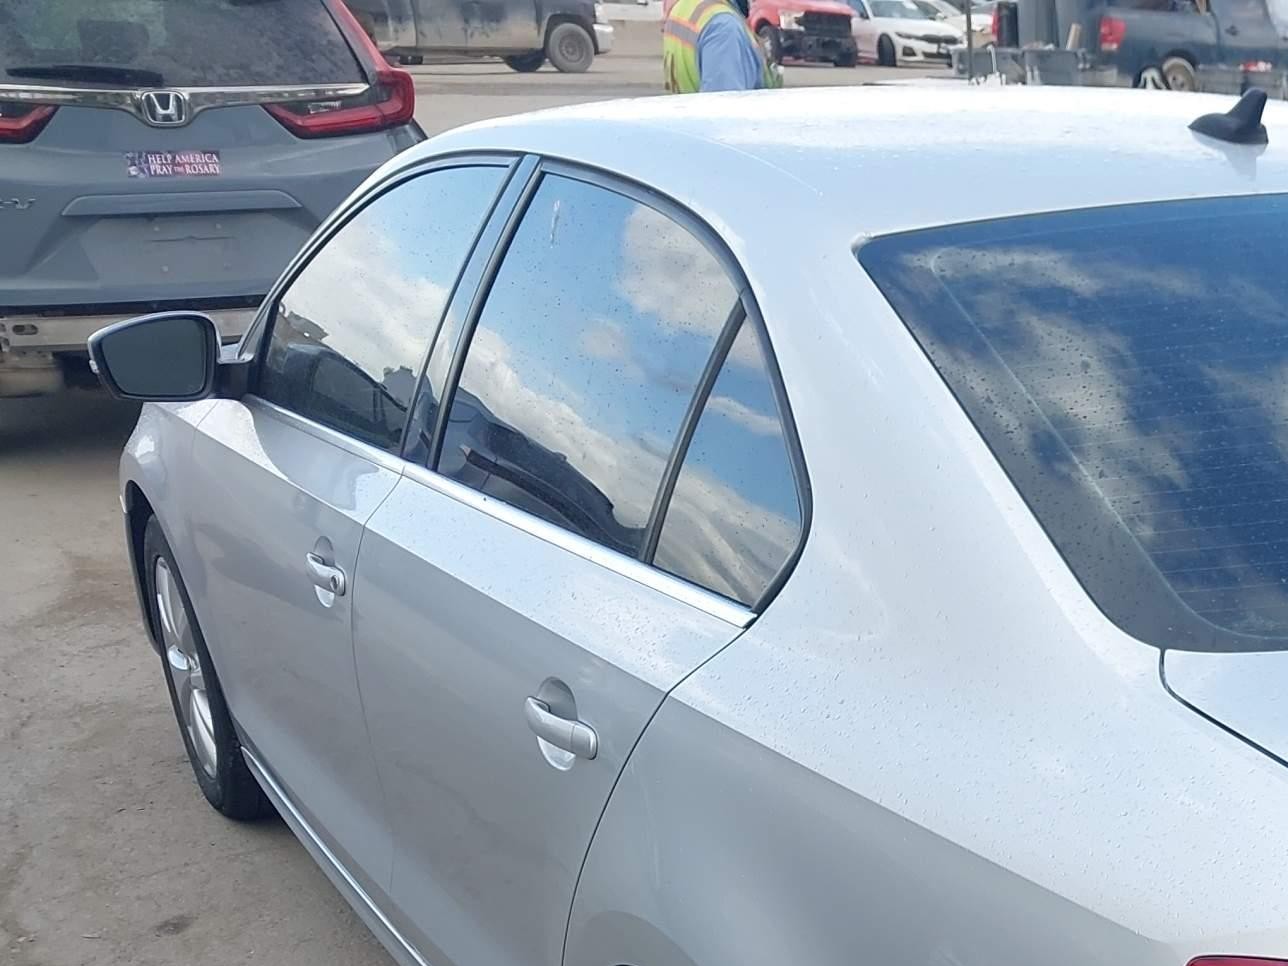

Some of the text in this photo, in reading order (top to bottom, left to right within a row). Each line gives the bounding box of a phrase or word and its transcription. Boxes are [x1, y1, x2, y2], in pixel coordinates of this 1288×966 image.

[147, 153, 219, 164] HELP AMERICA
[150, 164, 173, 175] PRAY
[185, 164, 220, 174] ROSARY
